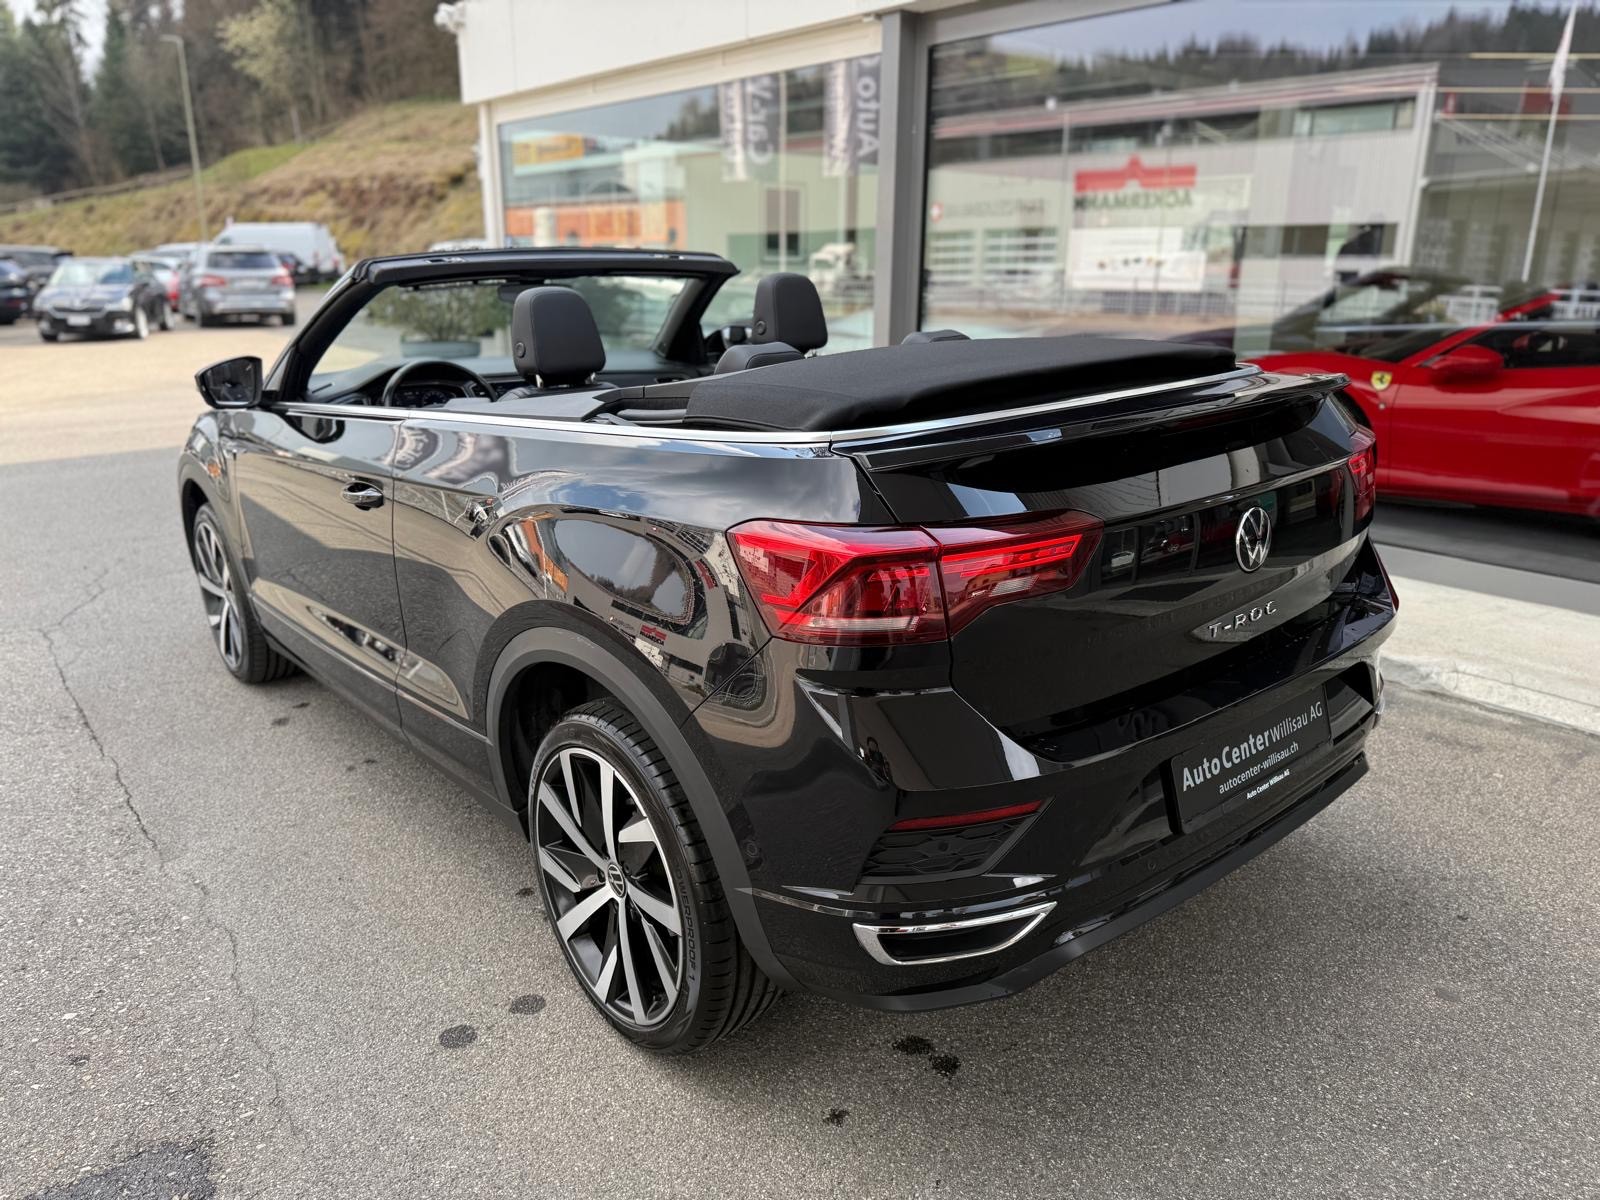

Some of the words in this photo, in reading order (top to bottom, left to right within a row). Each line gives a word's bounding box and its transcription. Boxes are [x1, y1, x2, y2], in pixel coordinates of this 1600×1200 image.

[1208, 600, 1277, 639] T-ROC
[1310, 701, 1323, 722] AG
[1219, 741, 1299, 794] autocenter-willisau.ch
[1246, 789, 1257, 799] Auto
[1256, 782, 1270, 794] Center
[1269, 773, 1284, 786] Willisau
[1284, 768, 1290, 777] AG
